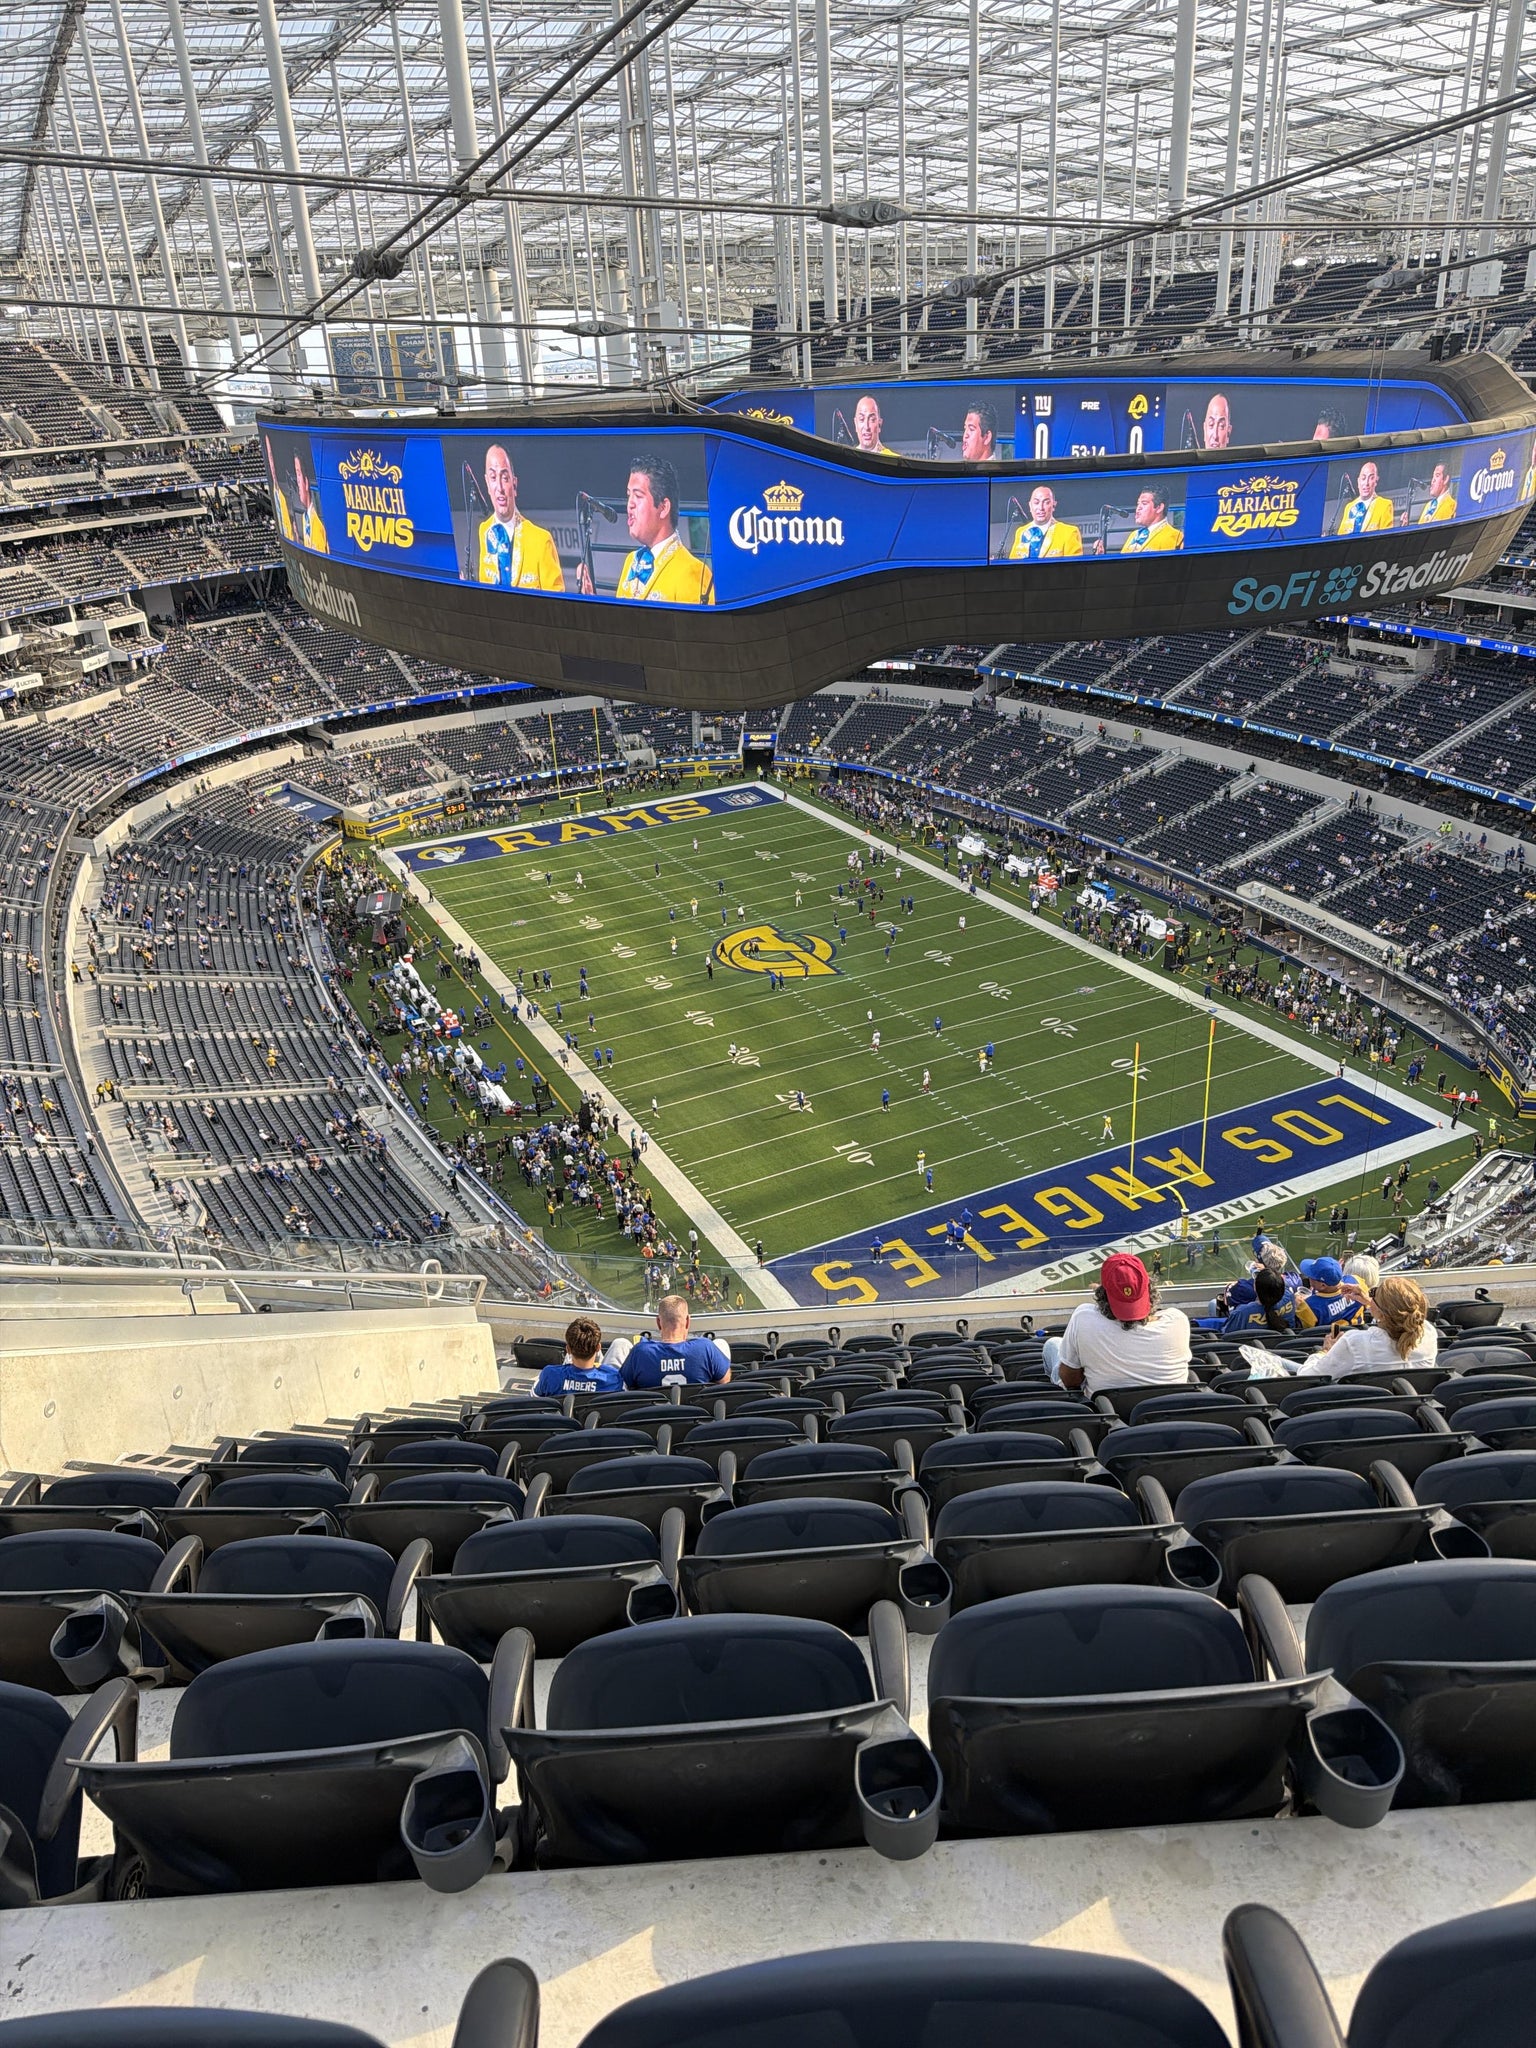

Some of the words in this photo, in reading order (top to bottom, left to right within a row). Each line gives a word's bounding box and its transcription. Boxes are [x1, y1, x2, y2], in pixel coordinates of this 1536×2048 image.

[417, 371, 439, 379] 202
[1081, 401, 1100, 410] PRE
[1470, 468, 1515, 503] Corona
[343, 483, 407, 515] MARIACHI
[1218, 493, 1296, 515] MARIACHI
[347, 512, 414, 552] RAMS
[729, 505, 845, 555] Corona
[1211, 509, 1299, 537] RAMS
[1227, 570, 1320, 615] SoFi
[1359, 550, 1474, 598] Stadium
[299, 562, 362, 628] Stadium
[446, 803, 465, 815] 53:13
[347, 824, 364, 835] AMS
[487, 799, 712, 854] RAMS
[645, 974, 673, 990] 50
[978, 981, 1013, 999] 30
[684, 1010, 714, 1026] 40
[1040, 1017, 1079, 1037] 20
[1110, 1058, 1152, 1079] 10
[1222, 1093, 1392, 1164] LOS
[832, 1140, 873, 1164] 10
[1269, 1184, 1298, 1201] IT
[1189, 1196, 1266, 1232] TAKES
[811, 1146, 1216, 1305] ANGELES
[1125, 1224, 1177, 1250] ALL
[1040, 1261, 1081, 1282] US
[660, 1358, 686, 1372] DART
[562, 1379, 597, 1393] NABERS
